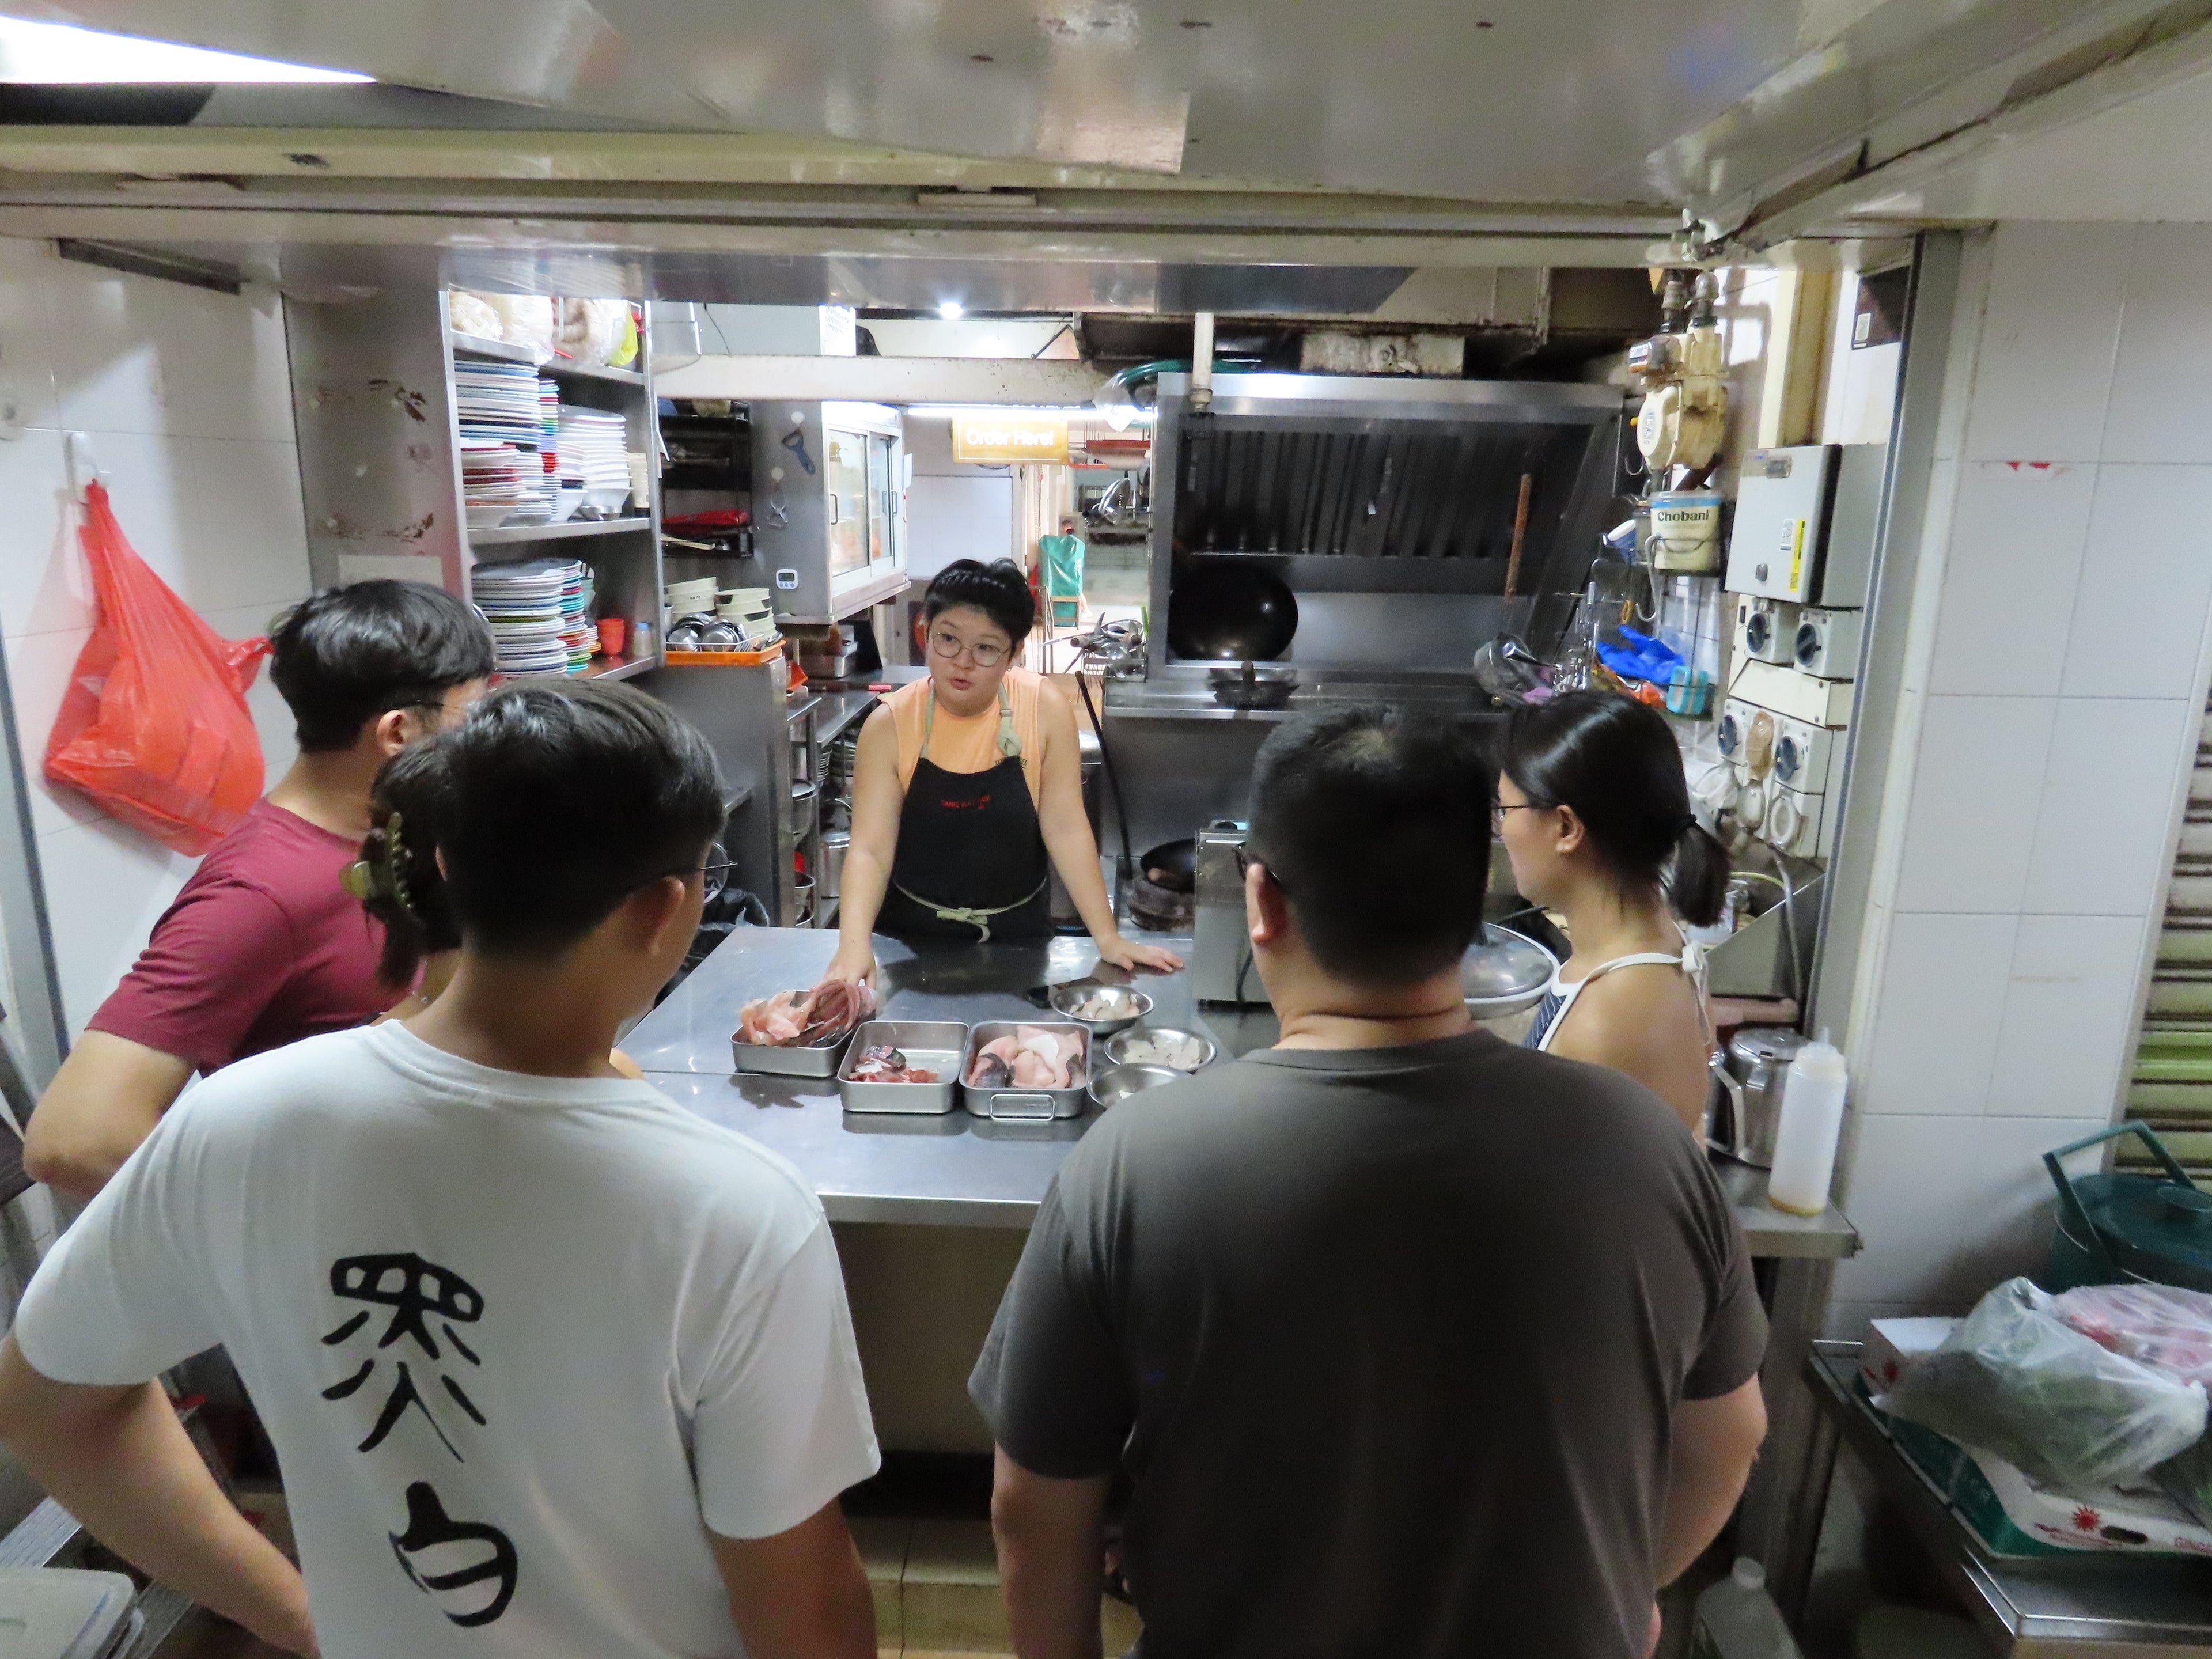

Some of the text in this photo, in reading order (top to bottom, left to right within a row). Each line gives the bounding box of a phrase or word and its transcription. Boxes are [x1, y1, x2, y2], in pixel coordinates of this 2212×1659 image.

[965, 429, 1054, 446] Order Here!
[1657, 509, 1709, 521] Chobani
